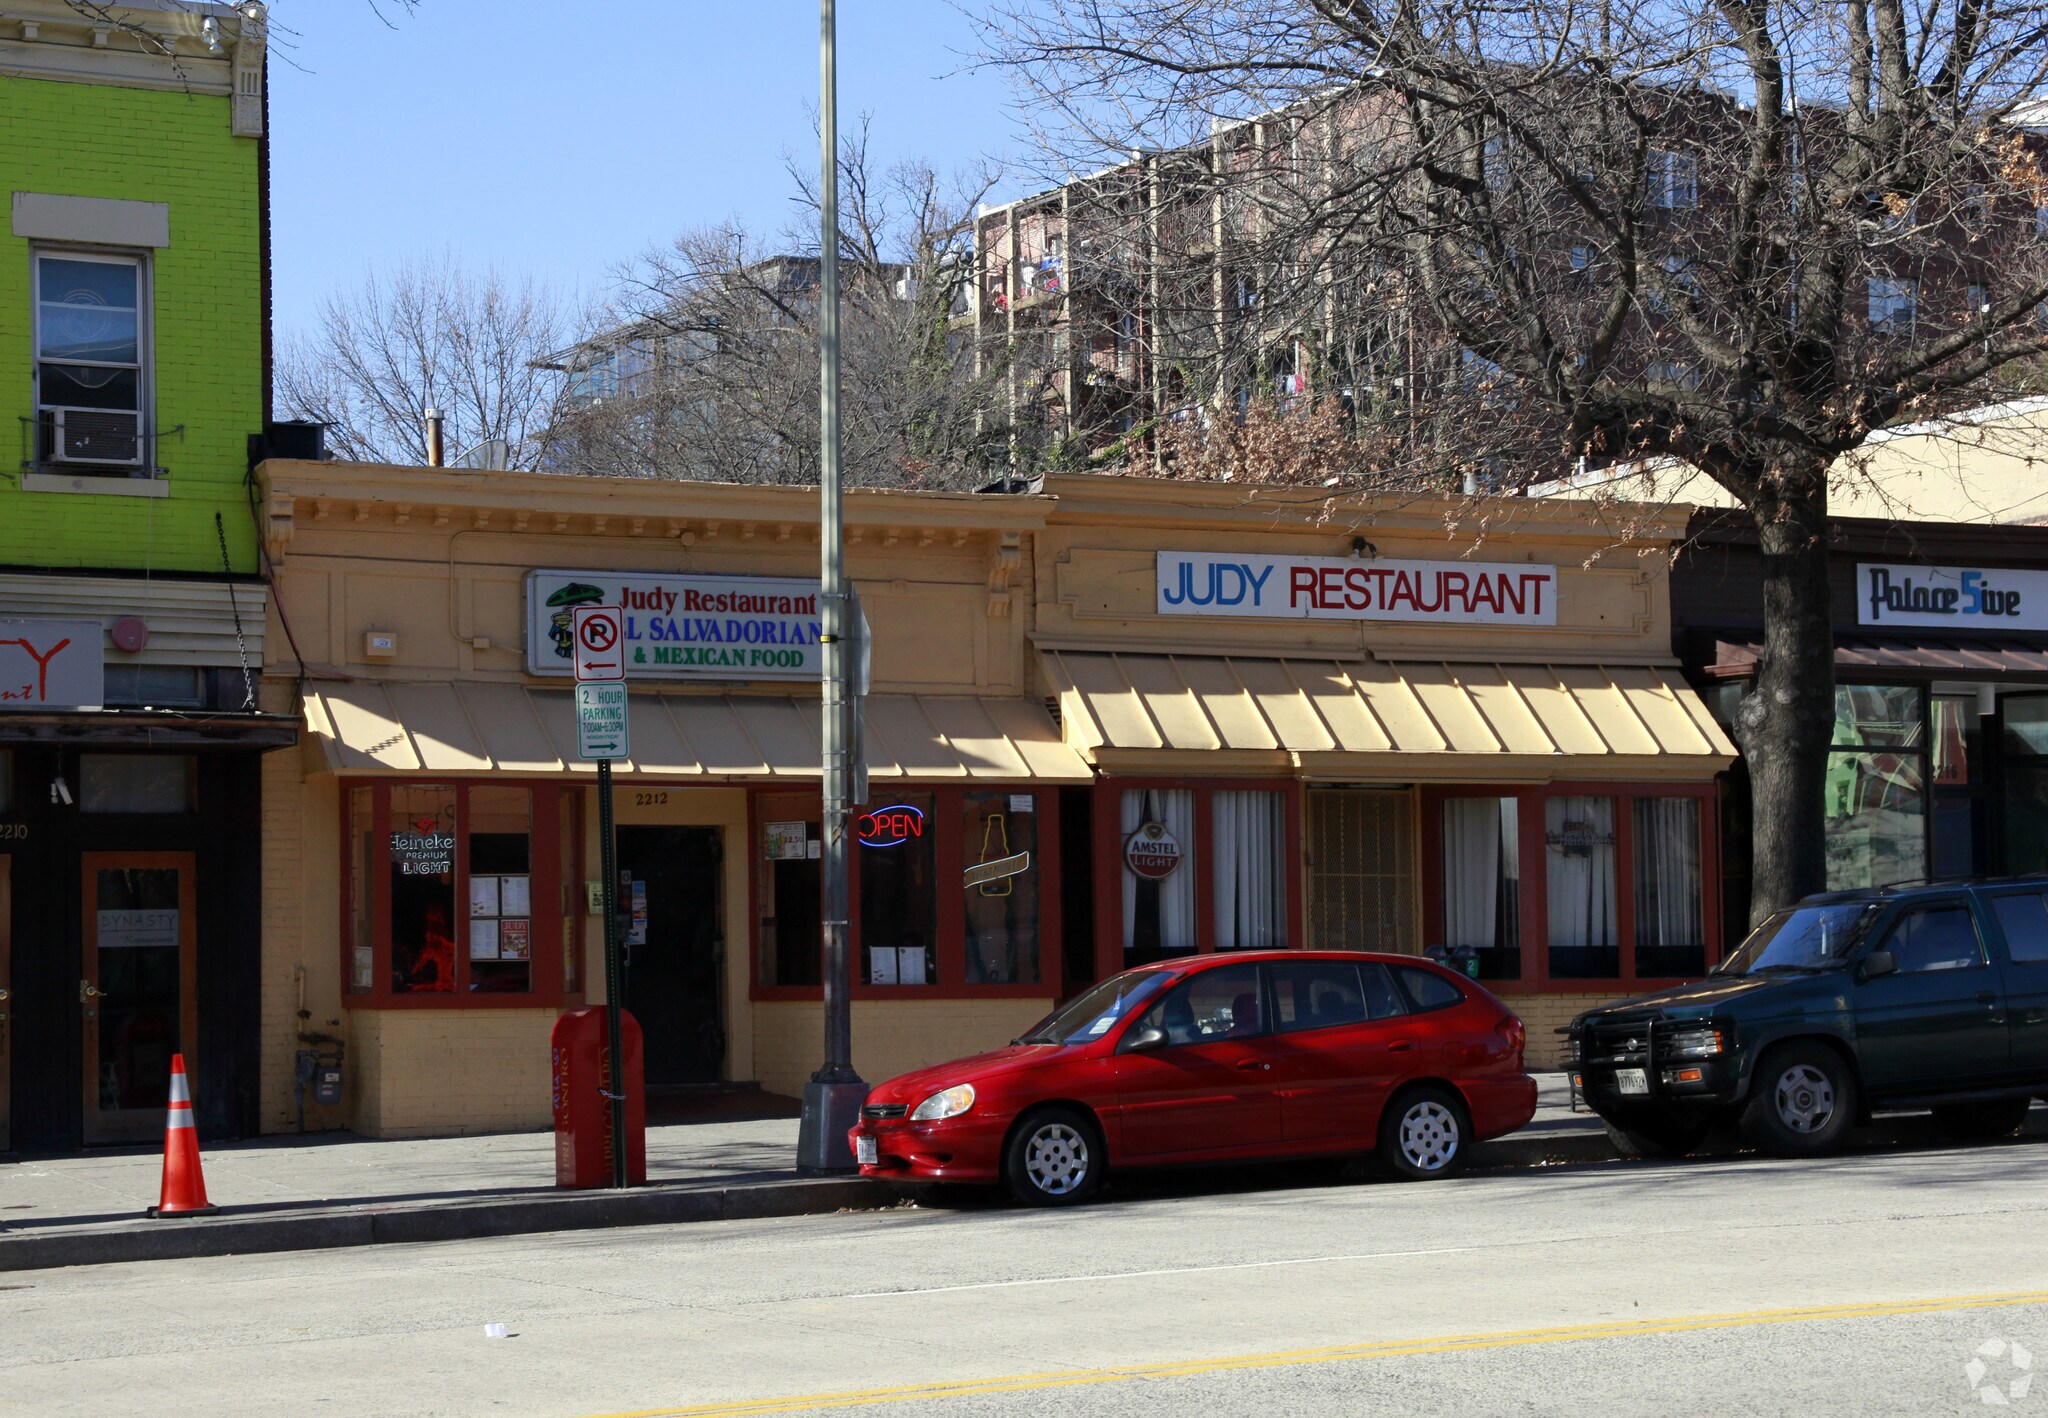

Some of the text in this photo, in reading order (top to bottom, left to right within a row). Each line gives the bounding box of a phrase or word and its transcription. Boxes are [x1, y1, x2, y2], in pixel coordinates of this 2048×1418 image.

[1163, 562, 1551, 616] JUDY RESTAURANT
[619, 586, 817, 616] Judy Restaurant
[634, 646, 804, 668] & MEXICAN FOOD
[583, 690, 623, 704] 2 HOUR
[583, 706, 622, 720] PARKING
[636, 792, 668, 806] 2212
[858, 814, 923, 837] OPEN
[390, 833, 456, 850] Heineke
[1132, 840, 1176, 855] AMSTEL
[406, 851, 448, 859] PREMIUM
[1134, 854, 1173, 867] LIGHT
[403, 861, 451, 875] LIGHT
[101, 913, 176, 929] DYNASTY
[504, 921, 527, 930] JUDY
[1467, 960, 1475, 971] 2
